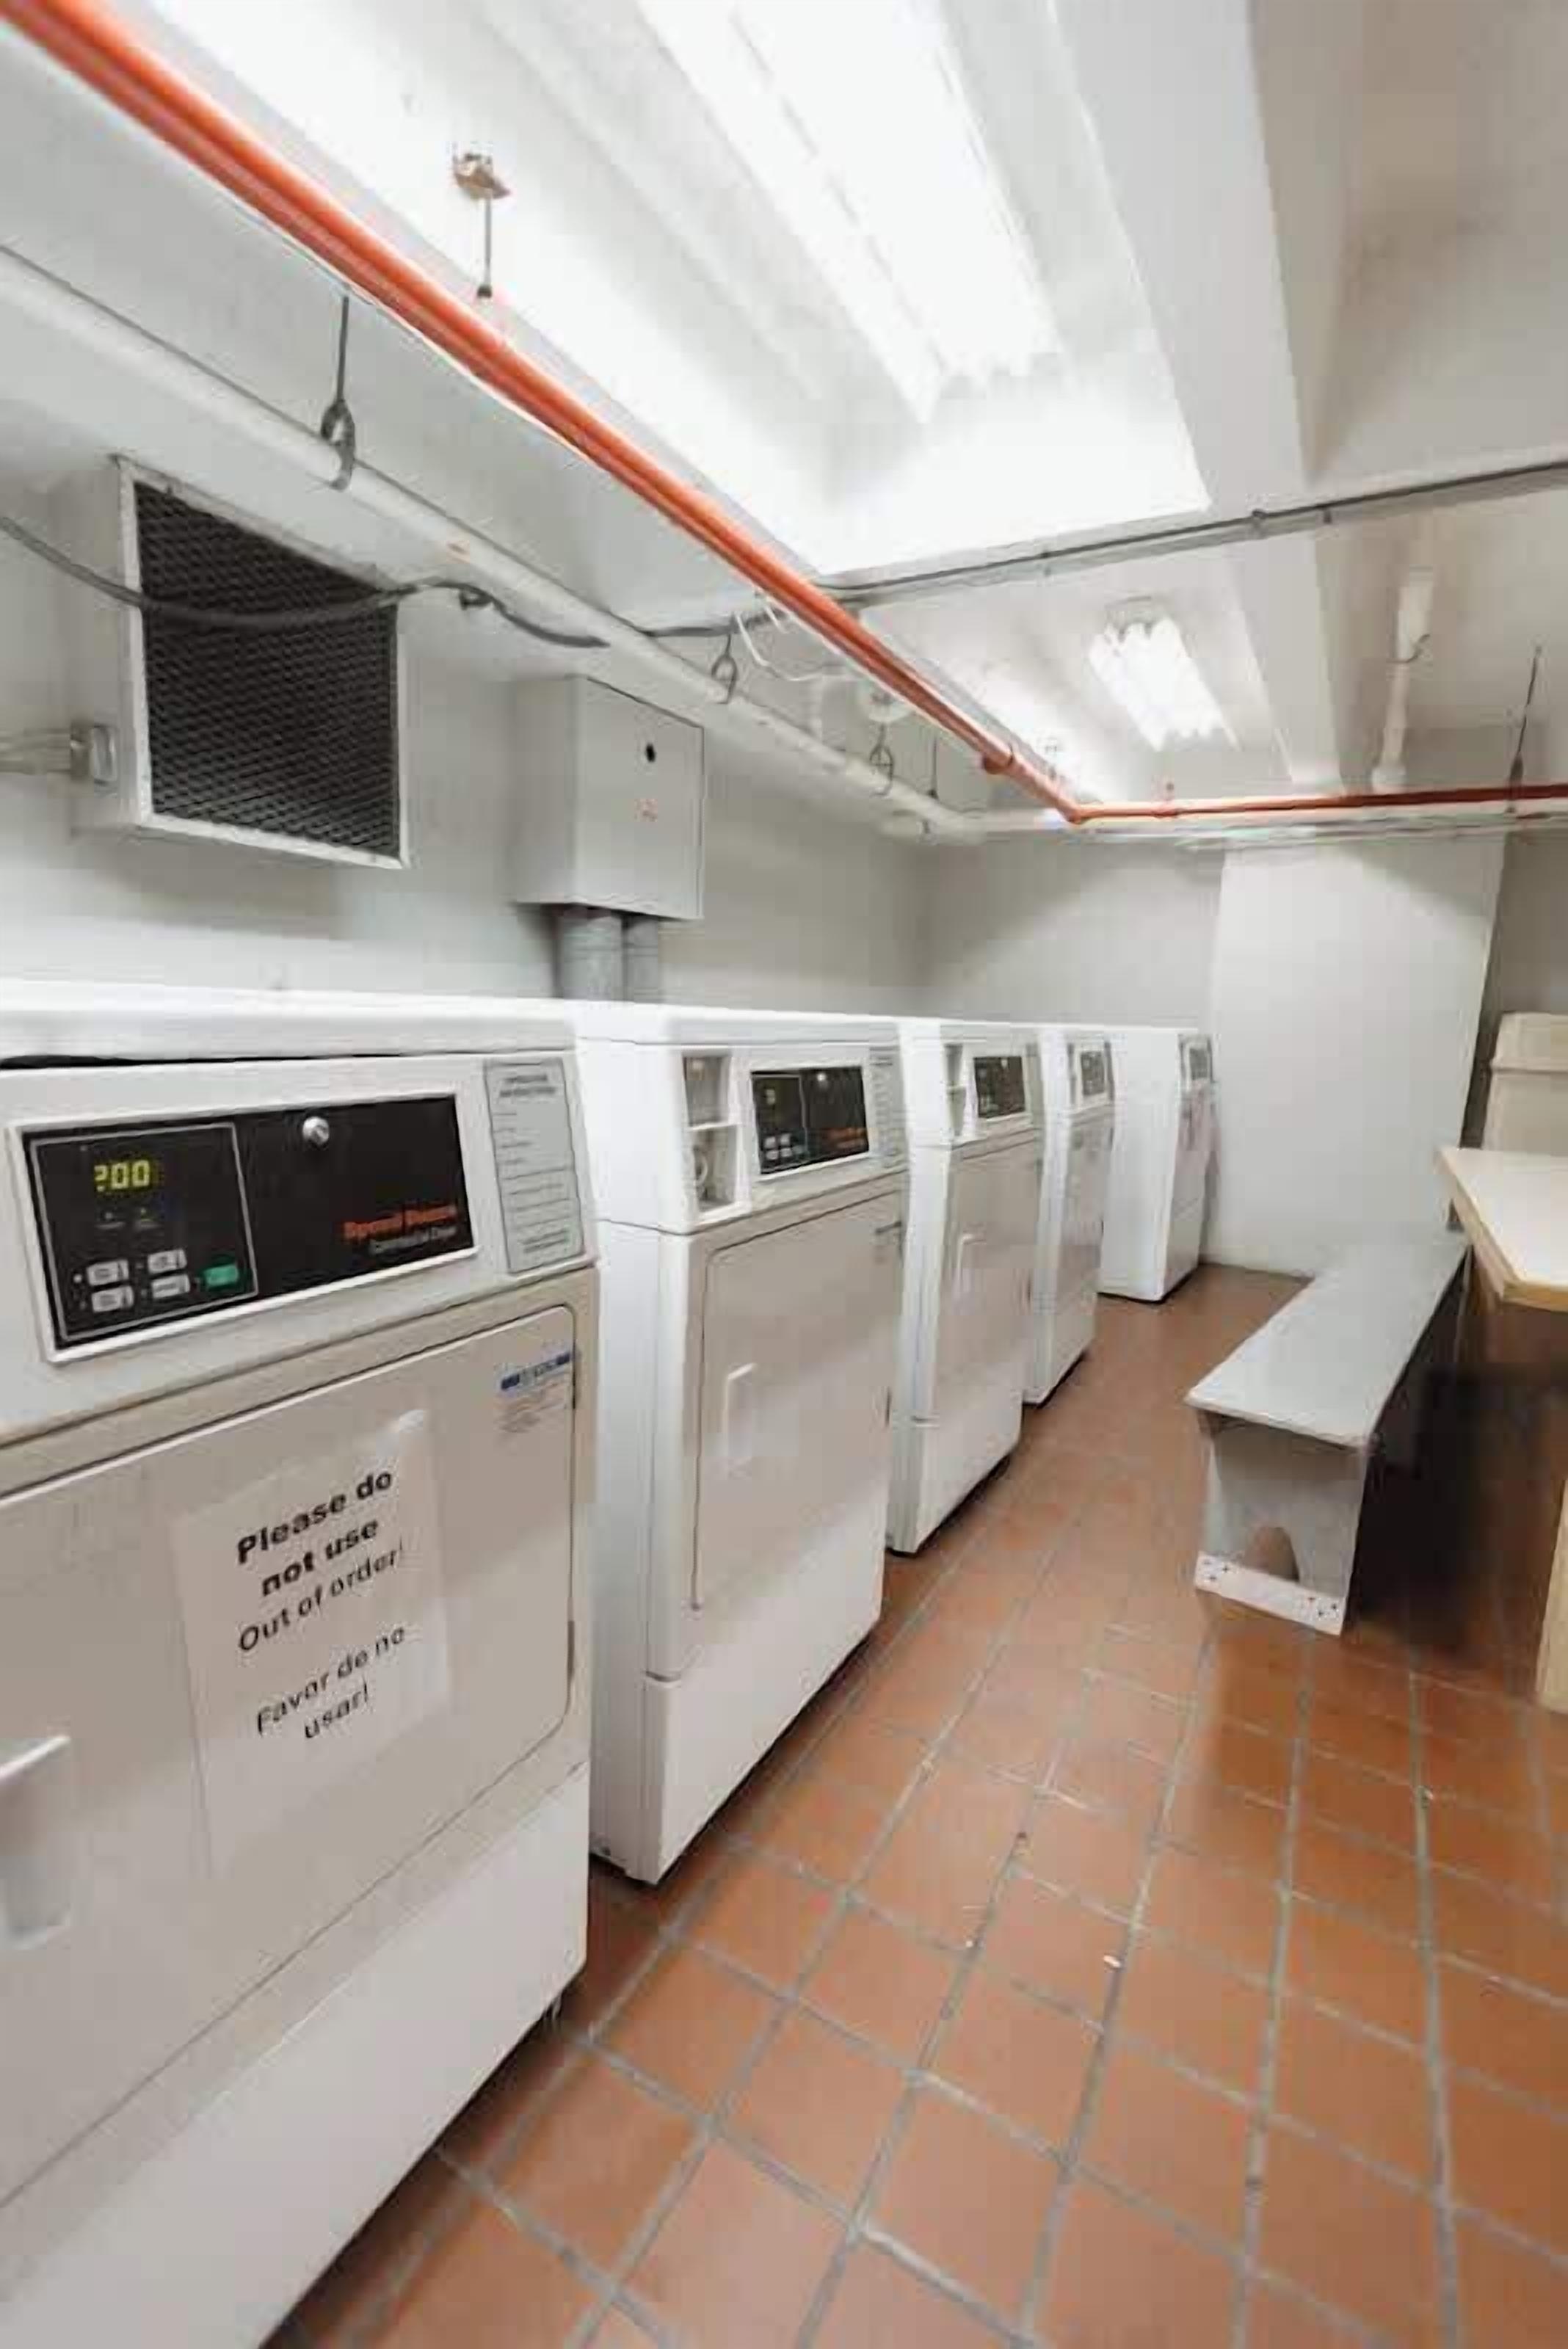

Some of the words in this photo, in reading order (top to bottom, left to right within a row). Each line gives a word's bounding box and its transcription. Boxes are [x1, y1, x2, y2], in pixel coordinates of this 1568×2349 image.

[237, 1493, 346, 1564] Please
[356, 1472, 392, 1500] do
[261, 1551, 314, 1597] not
[325, 1520, 378, 1560] use
[239, 1608, 291, 1651] Out
[298, 1585, 322, 1616] of
[257, 1671, 330, 1736] Favor
[337, 1650, 368, 1679] de
[376, 1626, 405, 1656] no
